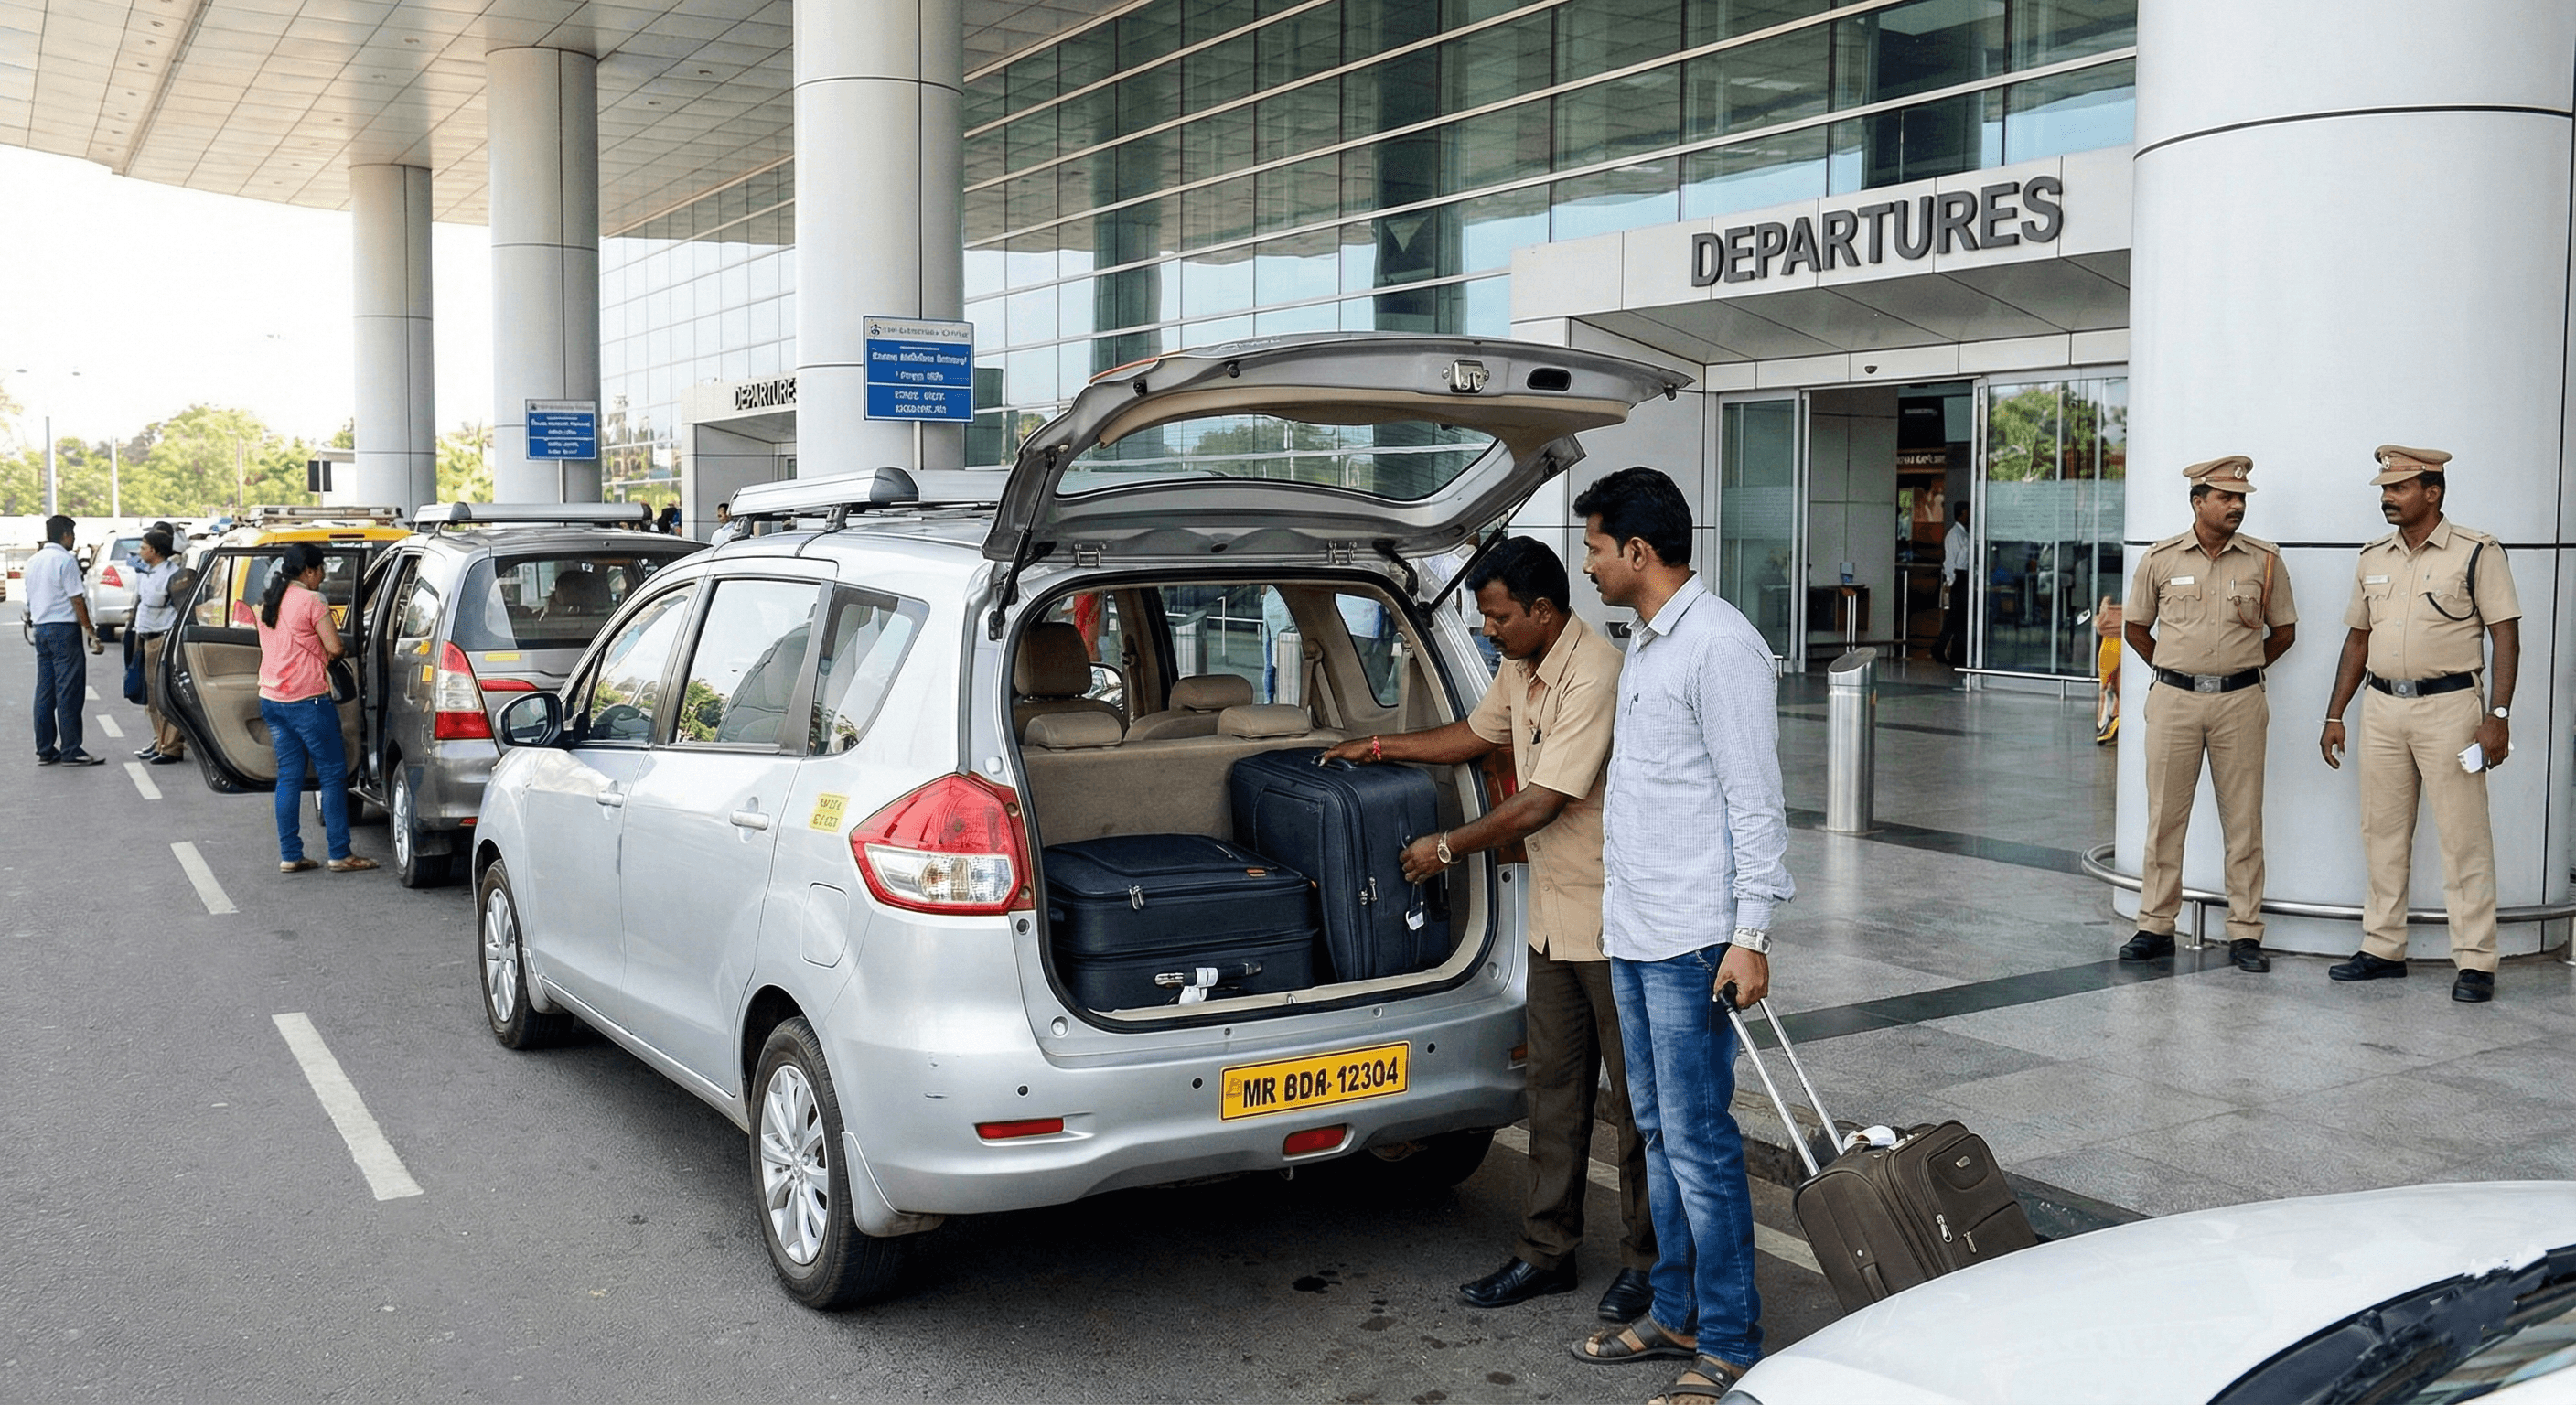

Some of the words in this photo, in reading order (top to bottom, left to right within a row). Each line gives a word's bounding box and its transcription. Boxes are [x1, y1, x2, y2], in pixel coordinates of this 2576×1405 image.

[1690, 175, 2065, 288] DEPARTURES
[1242, 1077, 1277, 1109] MR
[1336, 1056, 1399, 1094] 12304
